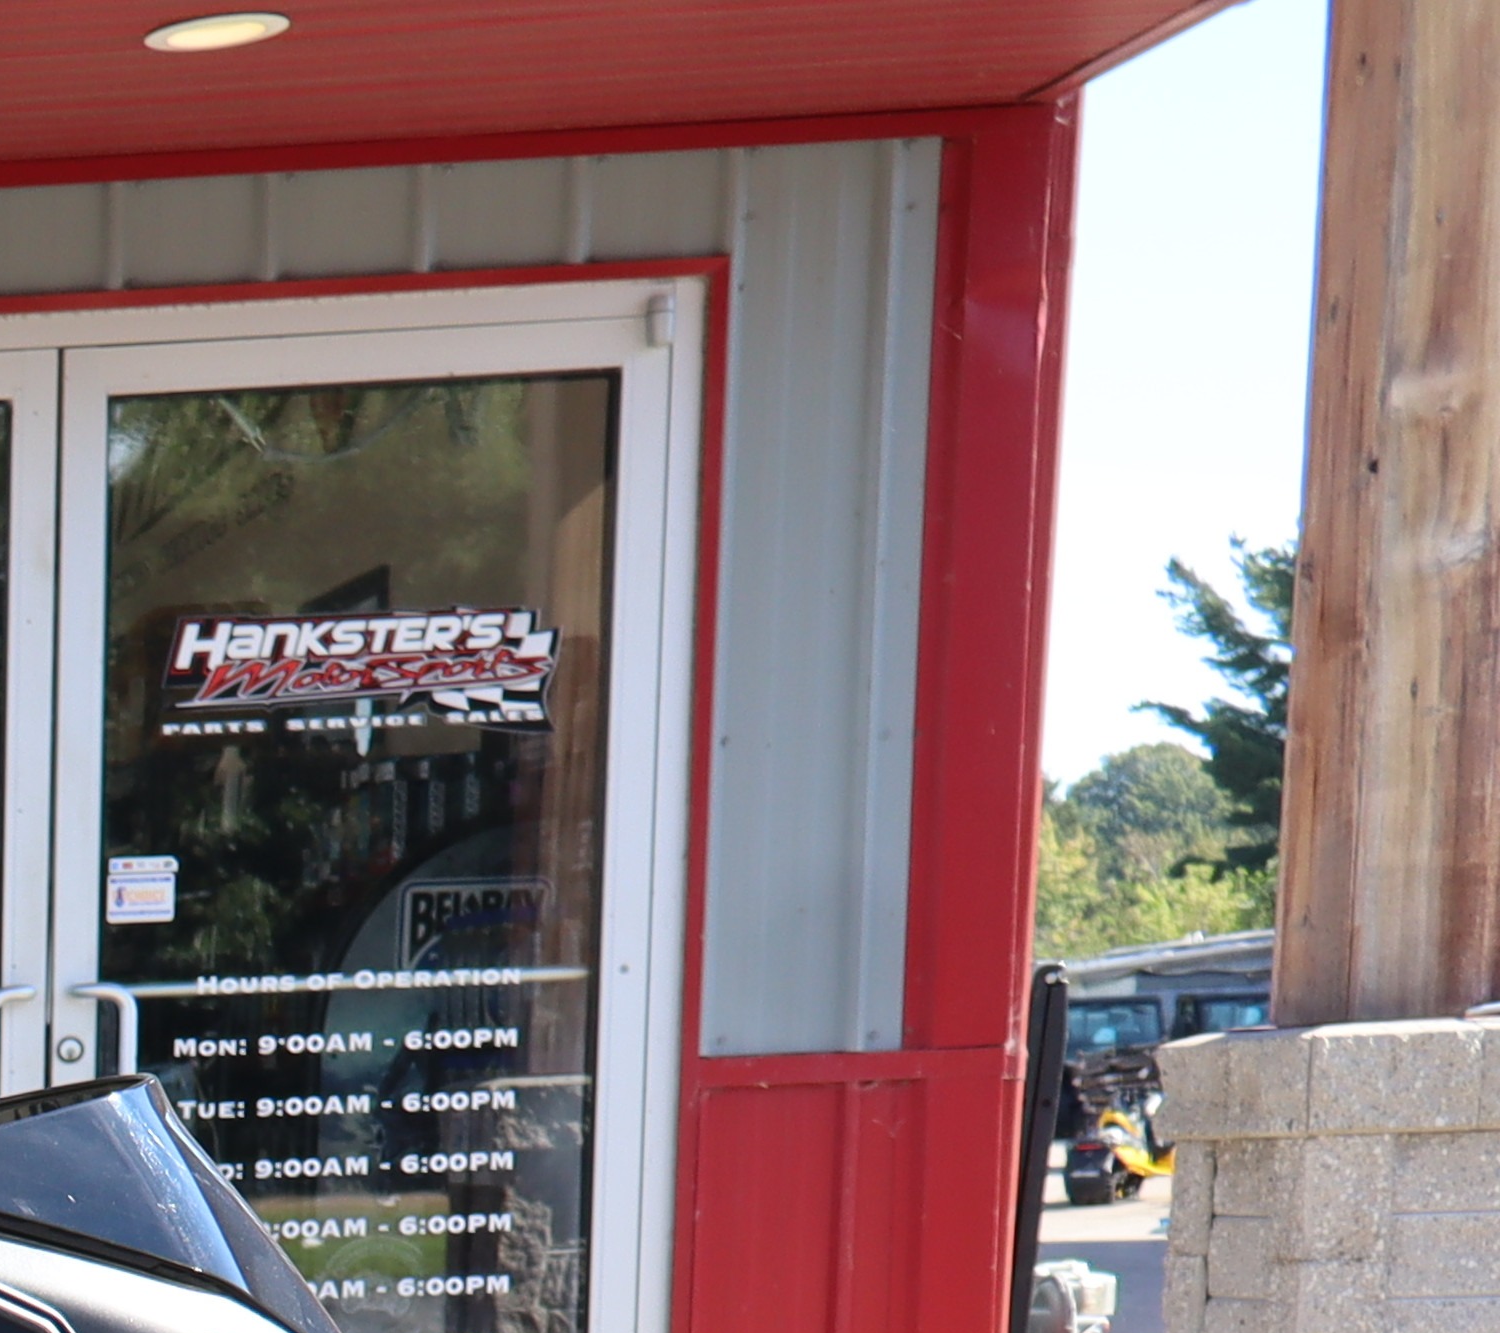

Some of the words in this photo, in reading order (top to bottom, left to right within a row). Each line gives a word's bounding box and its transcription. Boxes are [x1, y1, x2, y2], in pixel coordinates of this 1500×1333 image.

[162, 719, 266, 736] PARTS
[286, 713, 427, 733] SERVICE
[445, 708, 545, 726] SALES
[196, 974, 297, 996] HOURS
[306, 972, 344, 991] OF
[353, 967, 522, 989] OPERATION
[172, 1036, 248, 1059] MON:
[403, 1027, 520, 1051] 6:00PM
[176, 1100, 246, 1121] TUE:
[255, 1094, 371, 1118] 9:00AM
[401, 1090, 516, 1114] 6:00PM
[254, 1155, 369, 1180] 9:00AM
[399, 1151, 514, 1175] 6:00PM
[397, 1212, 513, 1236] 6:00PM
[395, 1274, 511, 1298] 6:00PM
